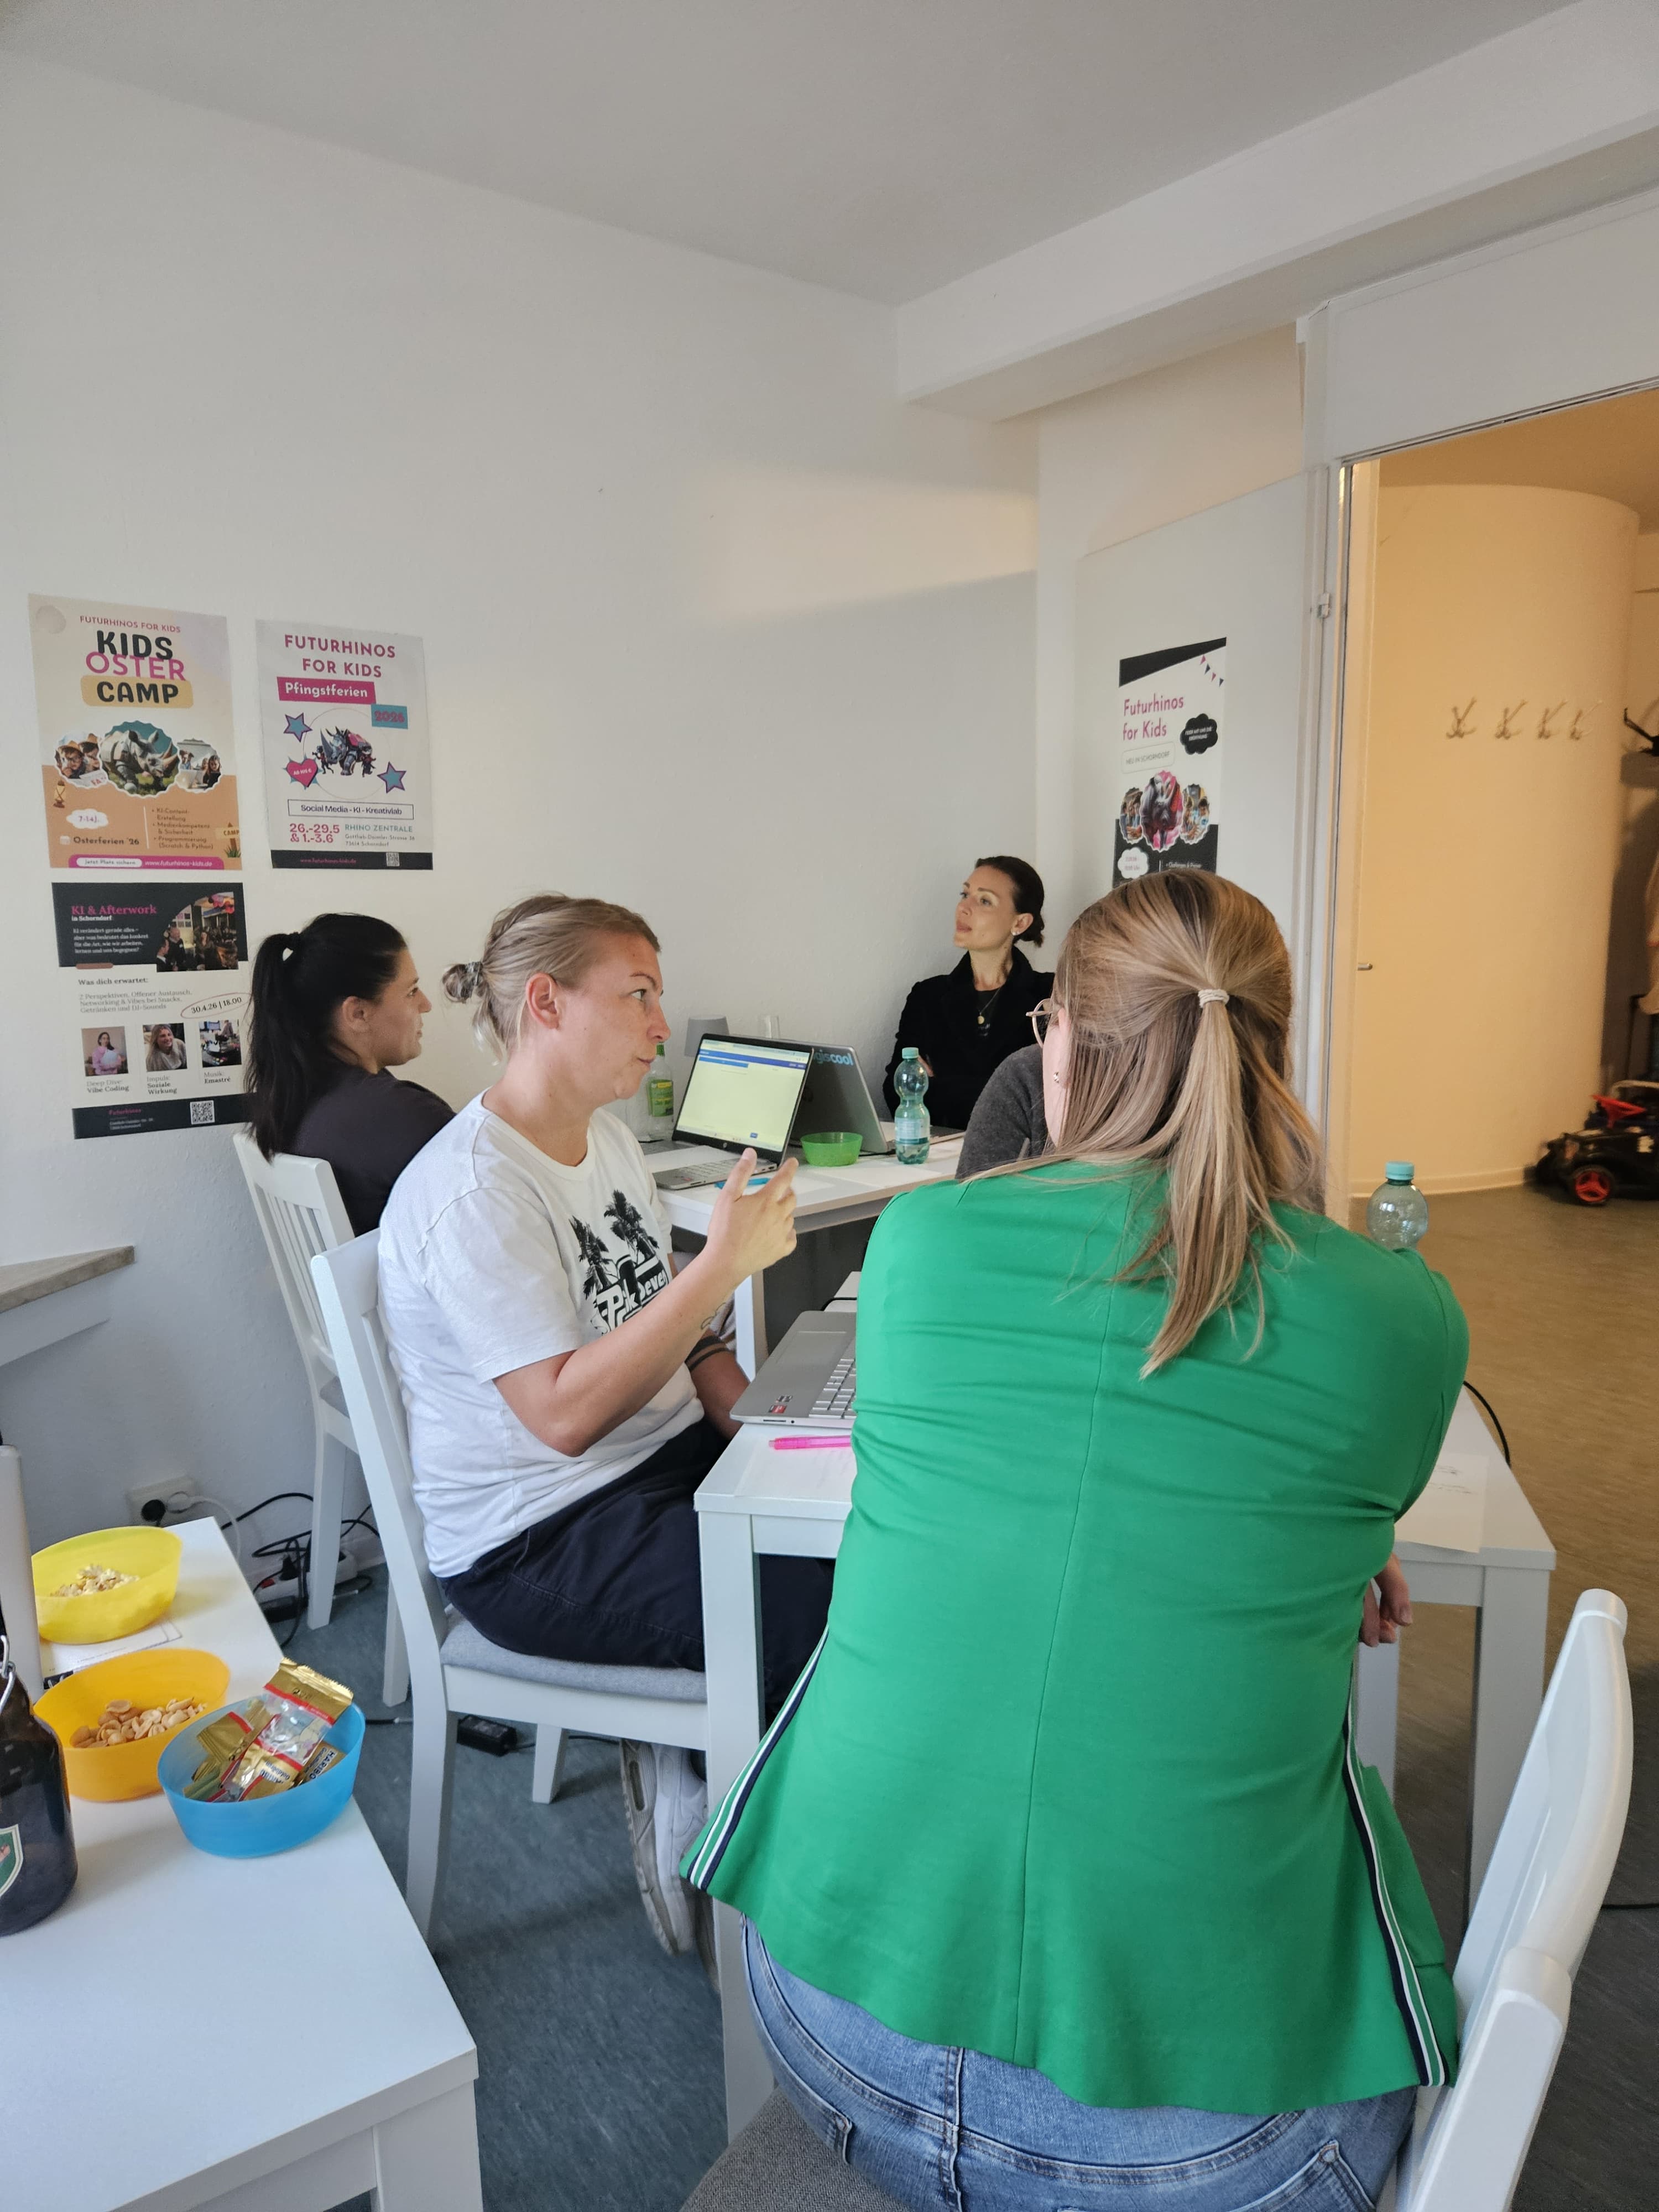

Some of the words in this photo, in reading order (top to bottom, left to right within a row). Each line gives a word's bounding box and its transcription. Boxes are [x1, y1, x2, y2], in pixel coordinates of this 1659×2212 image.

[80, 615, 138, 628] FUTURHINOS
[142, 622, 159, 630] FOR
[161, 624, 181, 634] KIDS
[97, 630, 173, 660] KIDS
[284, 634, 395, 658] FUTURHINOS
[86, 651, 186, 681] OSTER
[302, 658, 337, 674] FOR
[344, 662, 382, 678] KIDS
[97, 681, 179, 704] CAMP
[285, 682, 368, 698] Pfingstferien
[1124, 693, 1183, 717] Futurhinos
[374, 711, 405, 723] 2026
[1123, 722, 1138, 741] for
[1143, 717, 1167, 738] Kids
[290, 823, 340, 833] 26.-29.5
[73, 836, 124, 844] Osterferien
[290, 833, 300, 843] &
[302, 833, 333, 843] 1.-3.6
[71, 906, 85, 915] KI
[88, 906, 96, 915] &
[99, 904, 157, 914] Afterwork
[191, 1002, 217, 1014] 30.4.26
[223, 997, 242, 1006] 18.00
[814, 1049, 853, 1066] giscool
[310, 1751, 336, 1780] HARIBO
